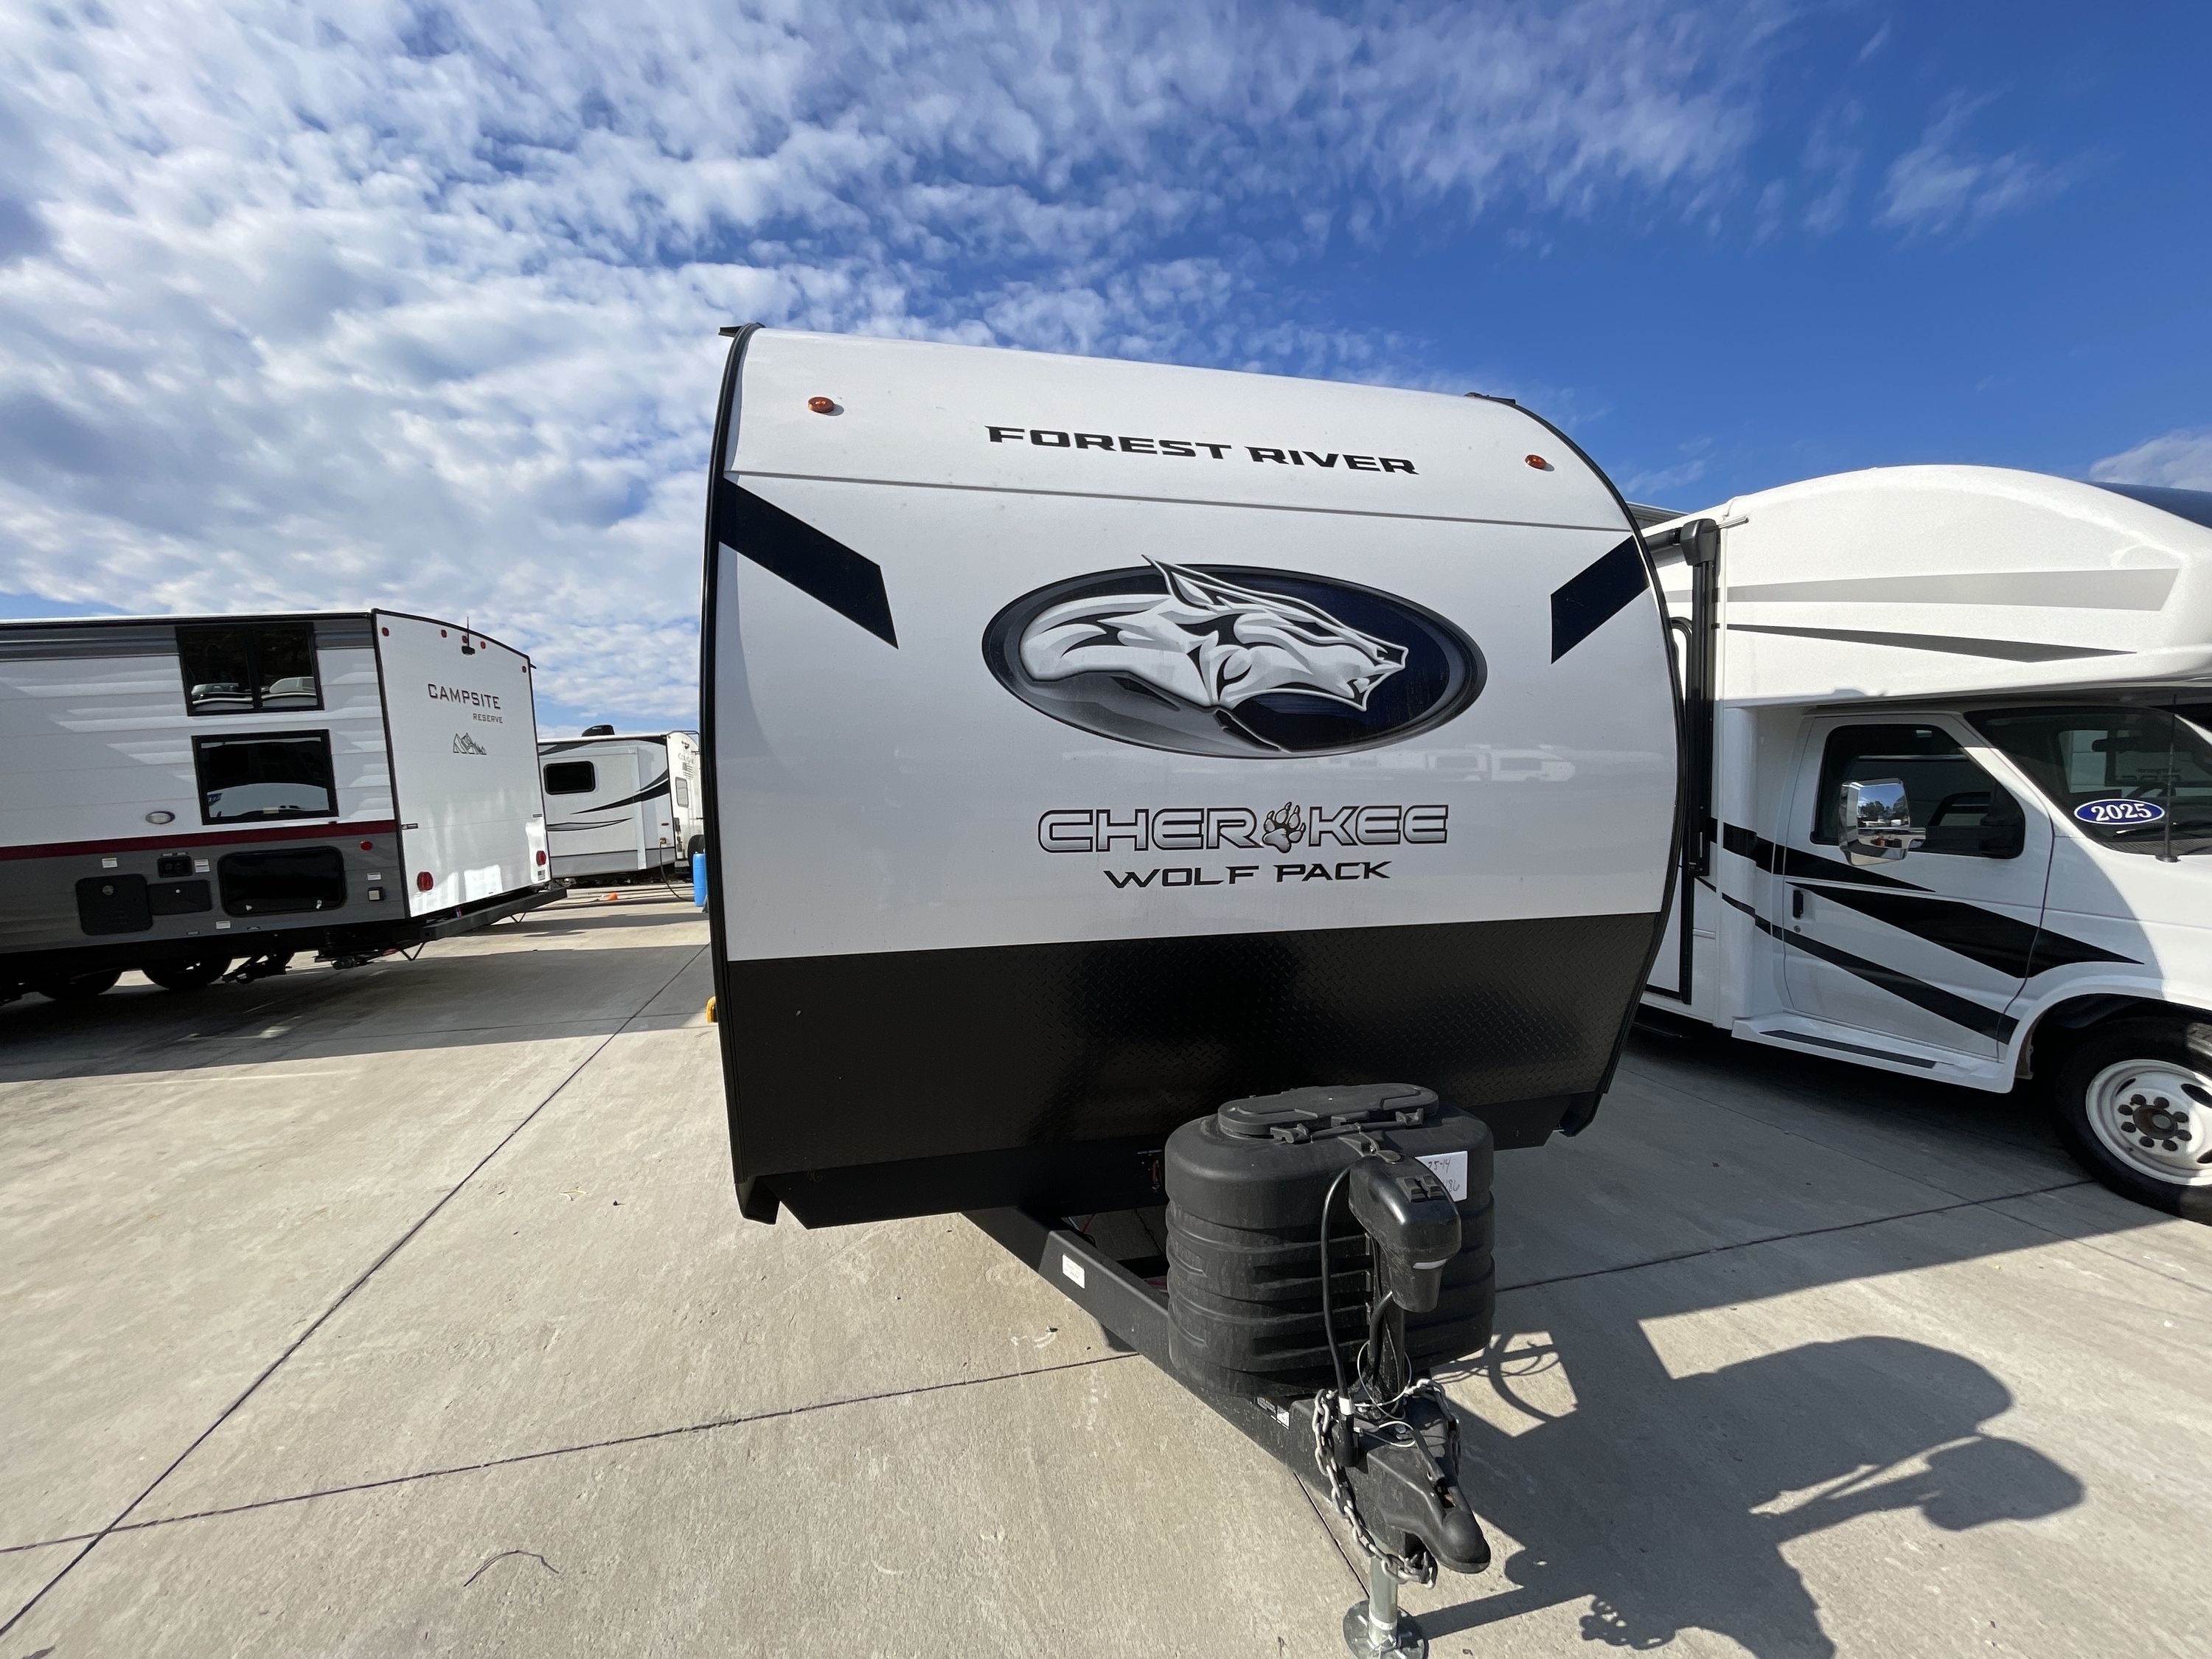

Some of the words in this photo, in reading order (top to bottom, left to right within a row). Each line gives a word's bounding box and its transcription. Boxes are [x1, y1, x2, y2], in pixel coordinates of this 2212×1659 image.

[984, 425, 1232, 459] FOREST
[1244, 446, 1420, 476] RIVER
[428, 683, 501, 709] CAMPSITE
[473, 713, 503, 724] RESERVE
[2090, 803, 2152, 821] 2025
[1103, 866, 1259, 888] WOLF
[1273, 861, 1392, 883] PACK
